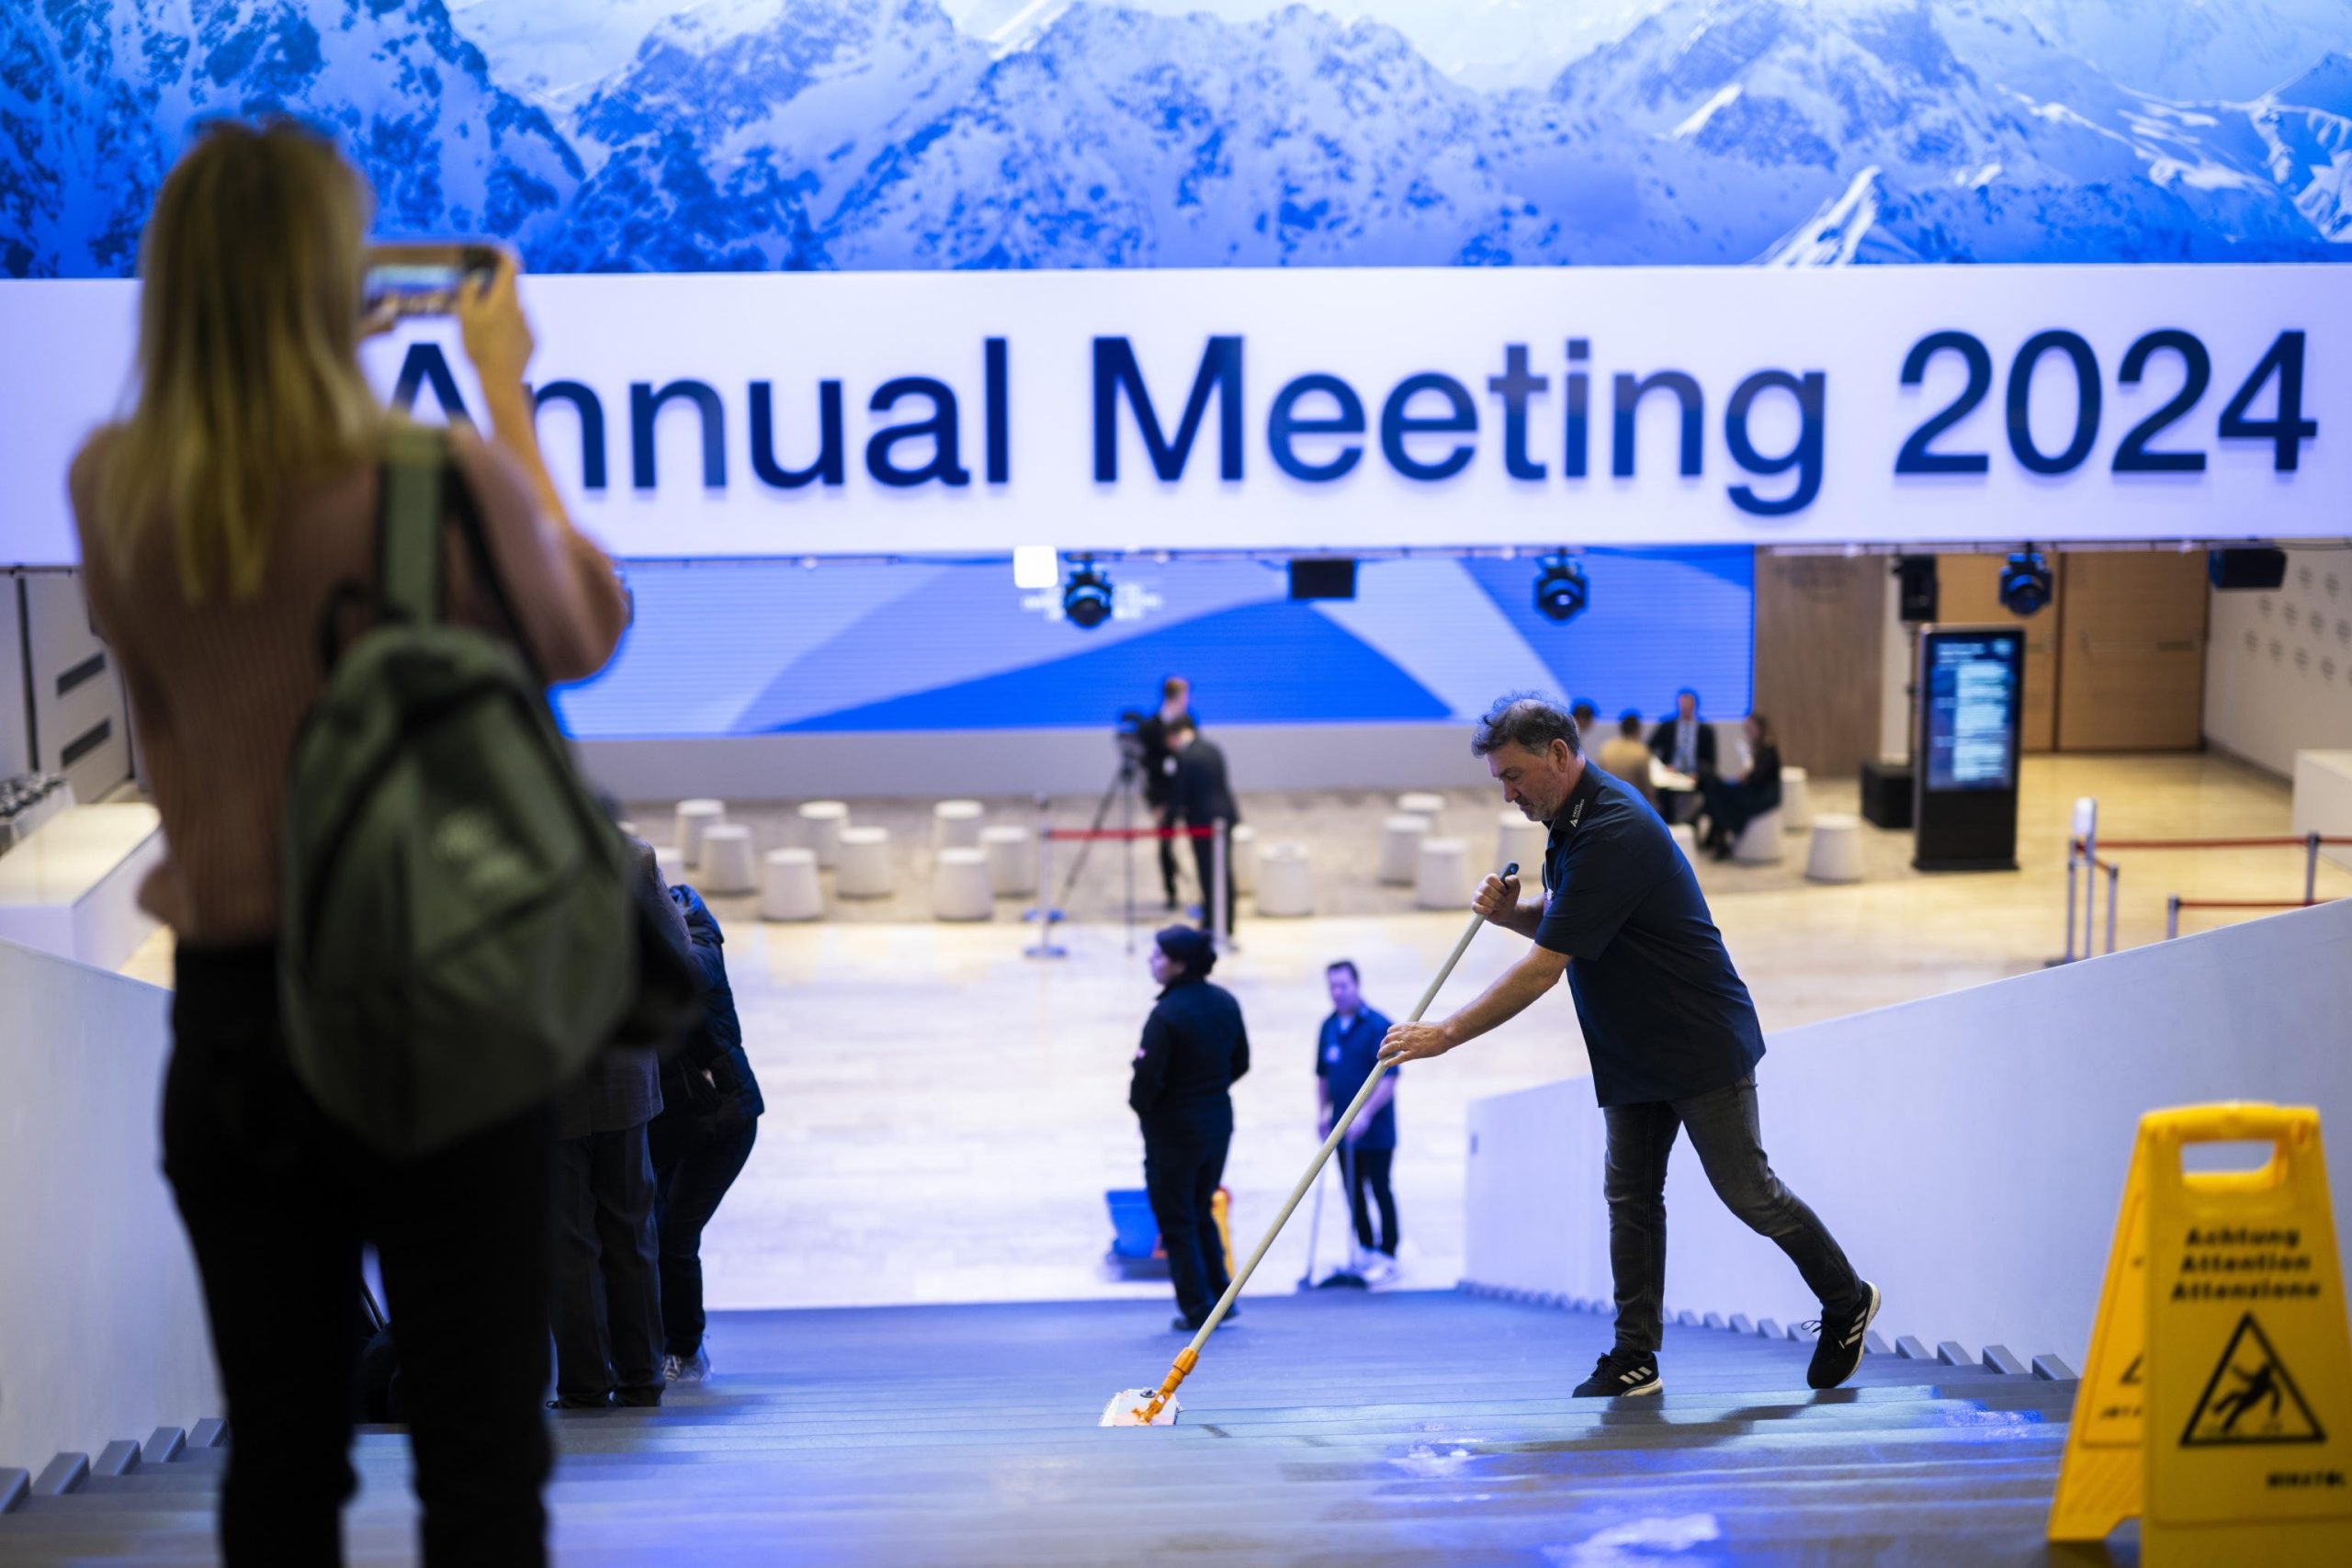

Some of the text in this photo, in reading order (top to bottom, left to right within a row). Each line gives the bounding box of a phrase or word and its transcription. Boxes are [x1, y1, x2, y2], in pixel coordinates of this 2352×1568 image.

[1091, 335, 1826, 517] Meeting
[1894, 329, 2319, 475] 2024
[2186, 1226, 2301, 1248] Achtung
[2180, 1253, 2311, 1274] Attention
